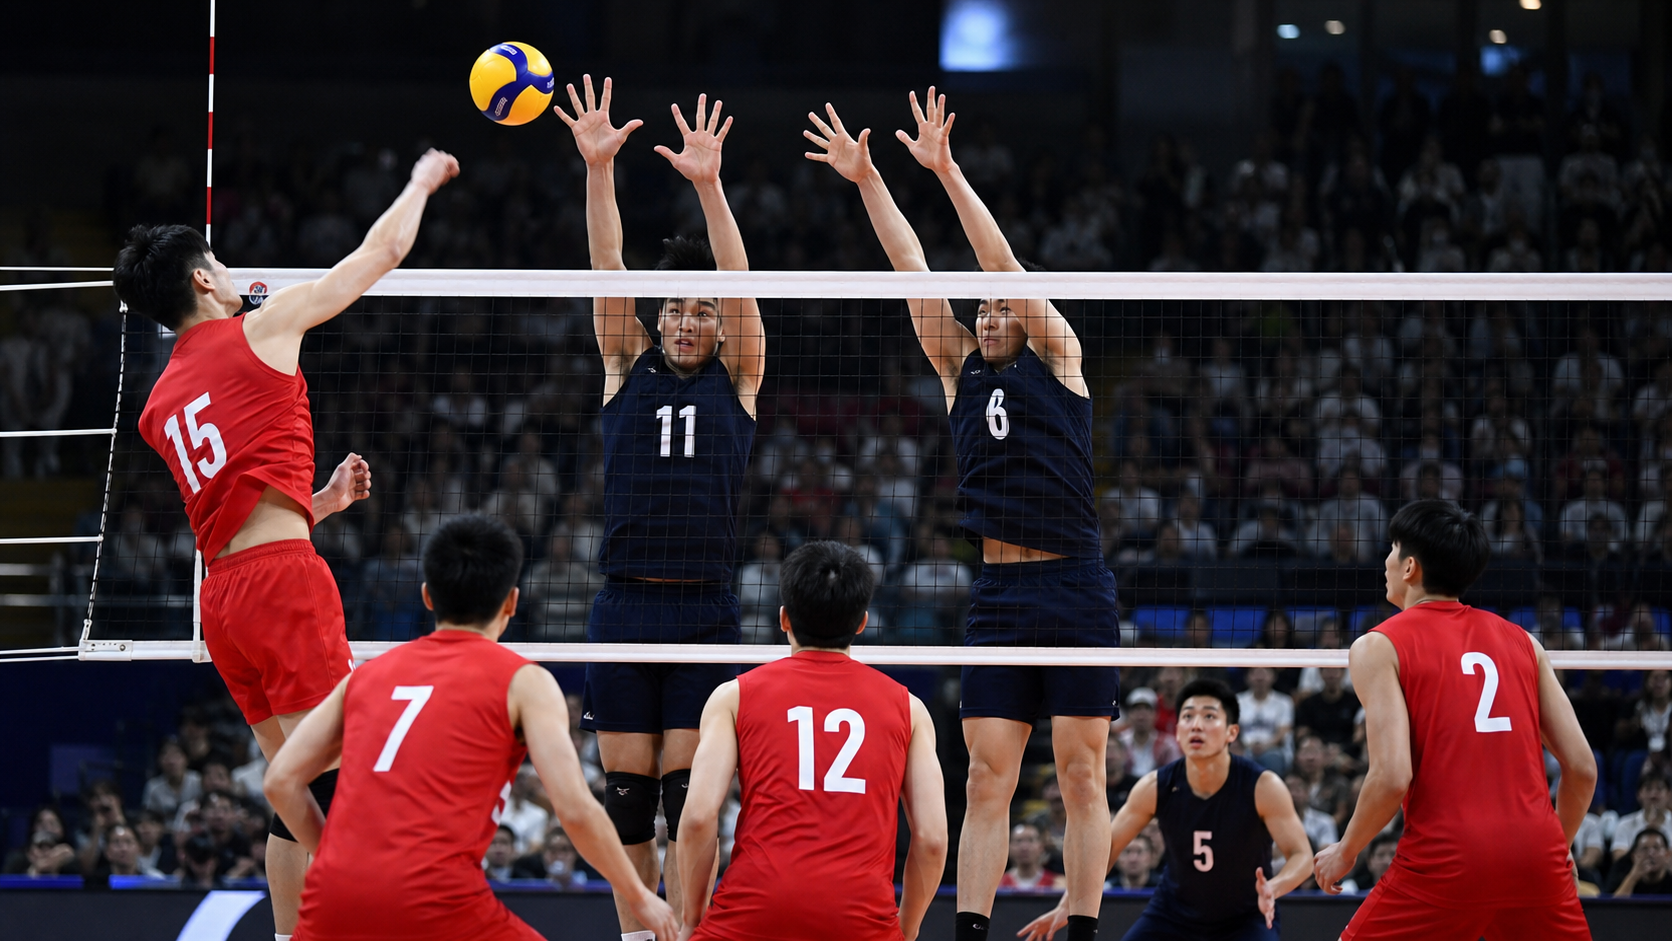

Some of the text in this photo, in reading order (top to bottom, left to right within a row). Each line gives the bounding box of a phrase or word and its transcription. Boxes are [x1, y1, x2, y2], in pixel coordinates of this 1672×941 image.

[164, 391, 227, 495] 15
[657, 405, 696, 458] 11
[985, 388, 1010, 440] 6
[373, 685, 435, 772] 7
[1460, 651, 1513, 733] 2
[787, 705, 866, 795] 12
[1193, 831, 1214, 872] 5
